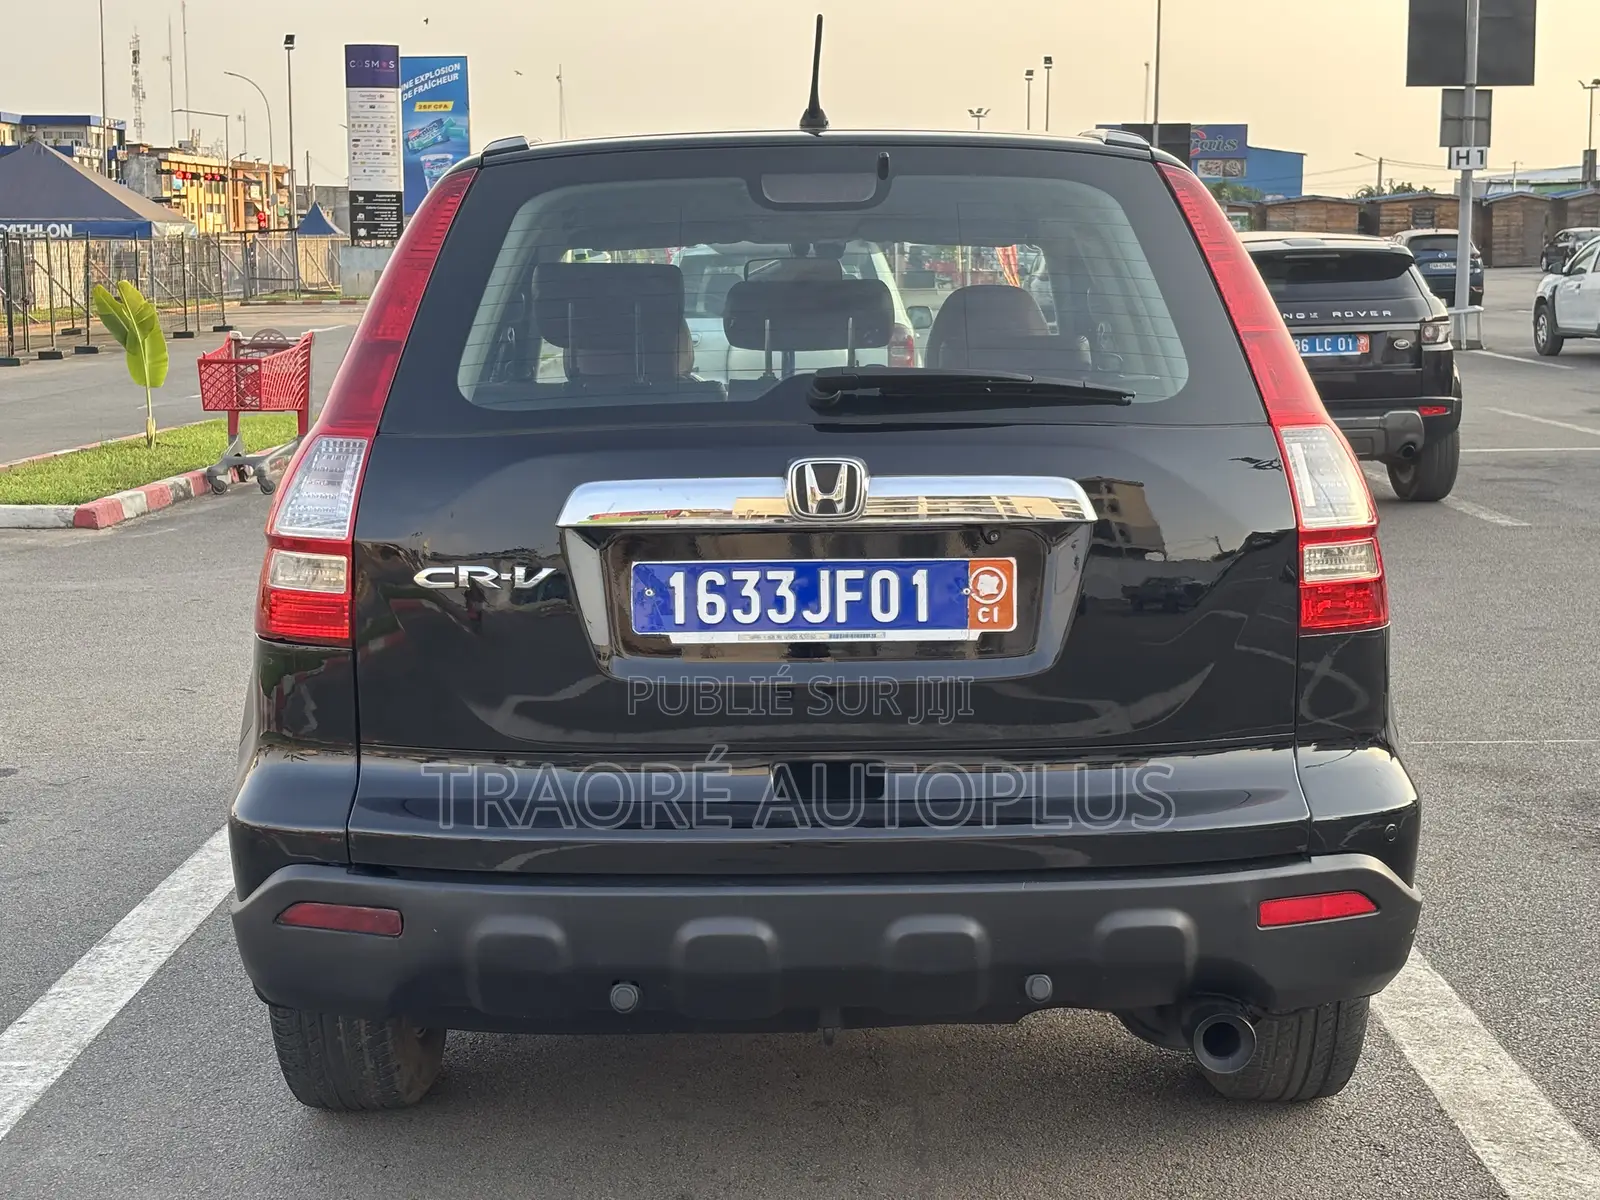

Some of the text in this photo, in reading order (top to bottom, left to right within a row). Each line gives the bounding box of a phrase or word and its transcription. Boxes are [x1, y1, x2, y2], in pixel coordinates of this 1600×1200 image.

[414, 62, 461, 86] EXPLOSION
[402, 90, 413, 102] DE
[1332, 310, 1392, 318] ROVER
[1315, 338, 1332, 352] LC
[1338, 337, 1353, 351] 01
[413, 565, 558, 589] CR-V
[668, 569, 929, 625] 1633JF01
[977, 606, 999, 623] CI
